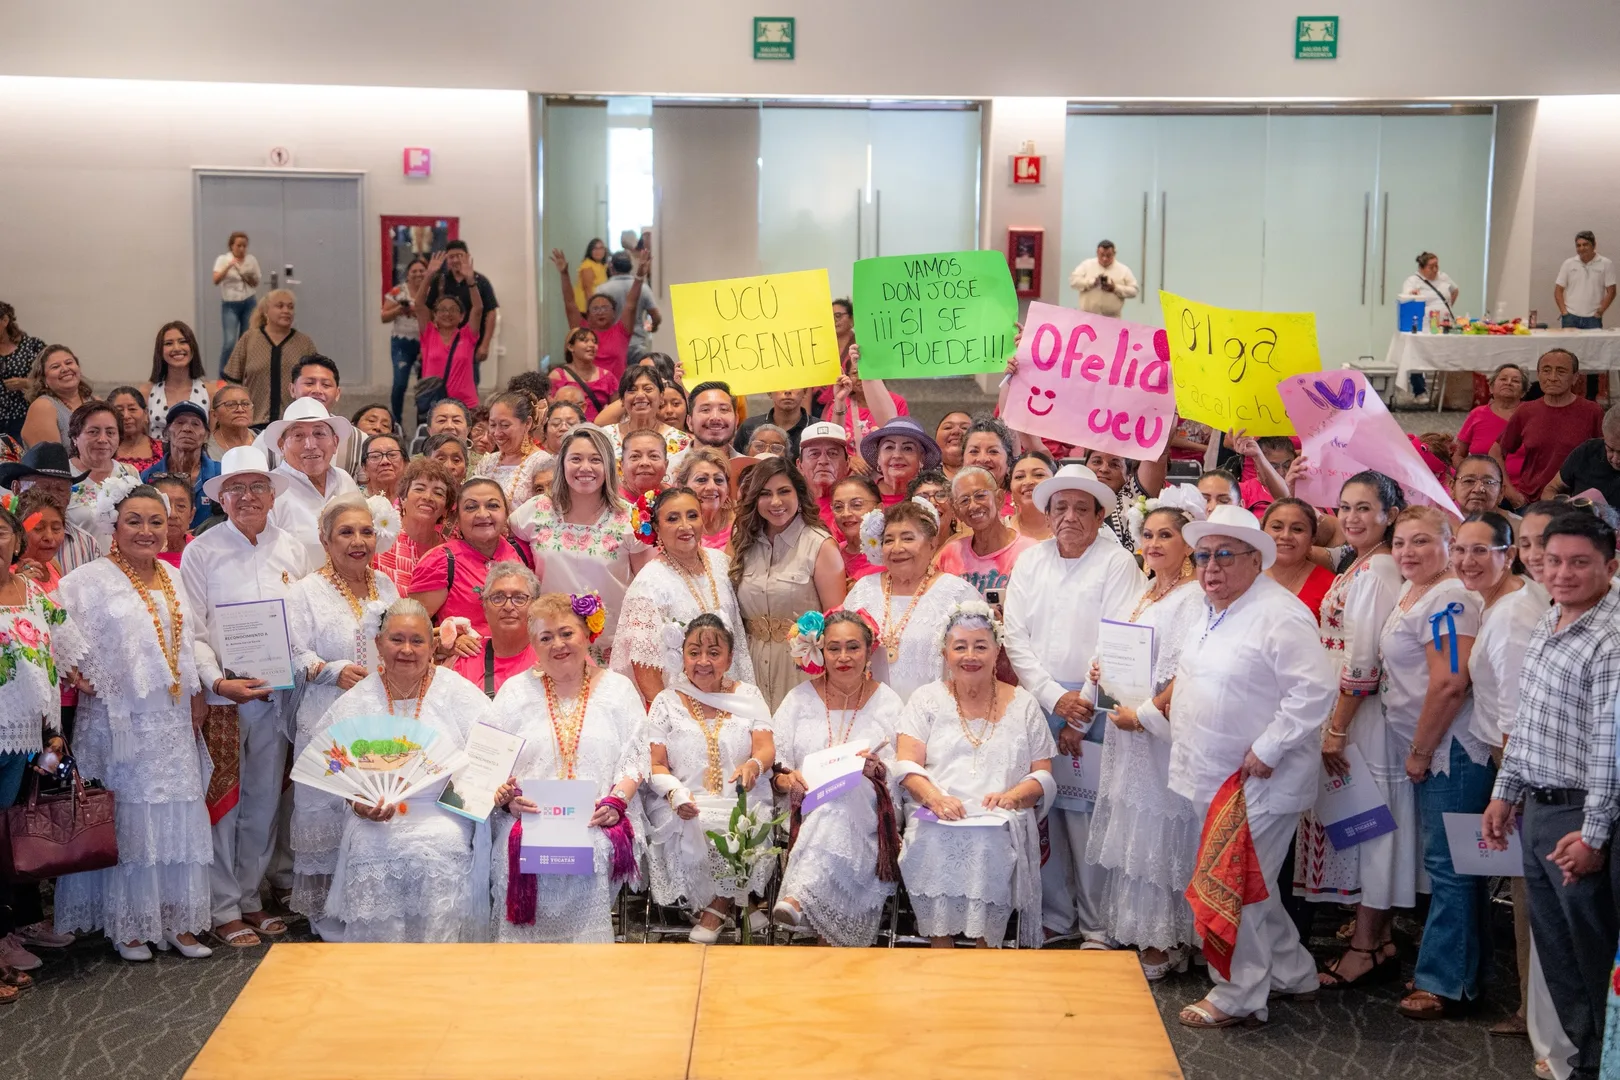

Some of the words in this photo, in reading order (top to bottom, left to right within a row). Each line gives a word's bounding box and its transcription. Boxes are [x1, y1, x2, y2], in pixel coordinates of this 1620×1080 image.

[904, 257, 962, 280] VAMOS
[714, 279, 778, 321] UCÚ
[882, 281, 920, 301] DON
[938, 308, 966, 331] SE
[689, 326, 830, 375] PRESENTE
[893, 334, 1004, 368] PUEDE!!!
[1031, 323, 1169, 394] Ofelia
[1181, 308, 1281, 383] Olga
[1174, 353, 1290, 424] Cacalch
[553, 807, 575, 815] DIF
